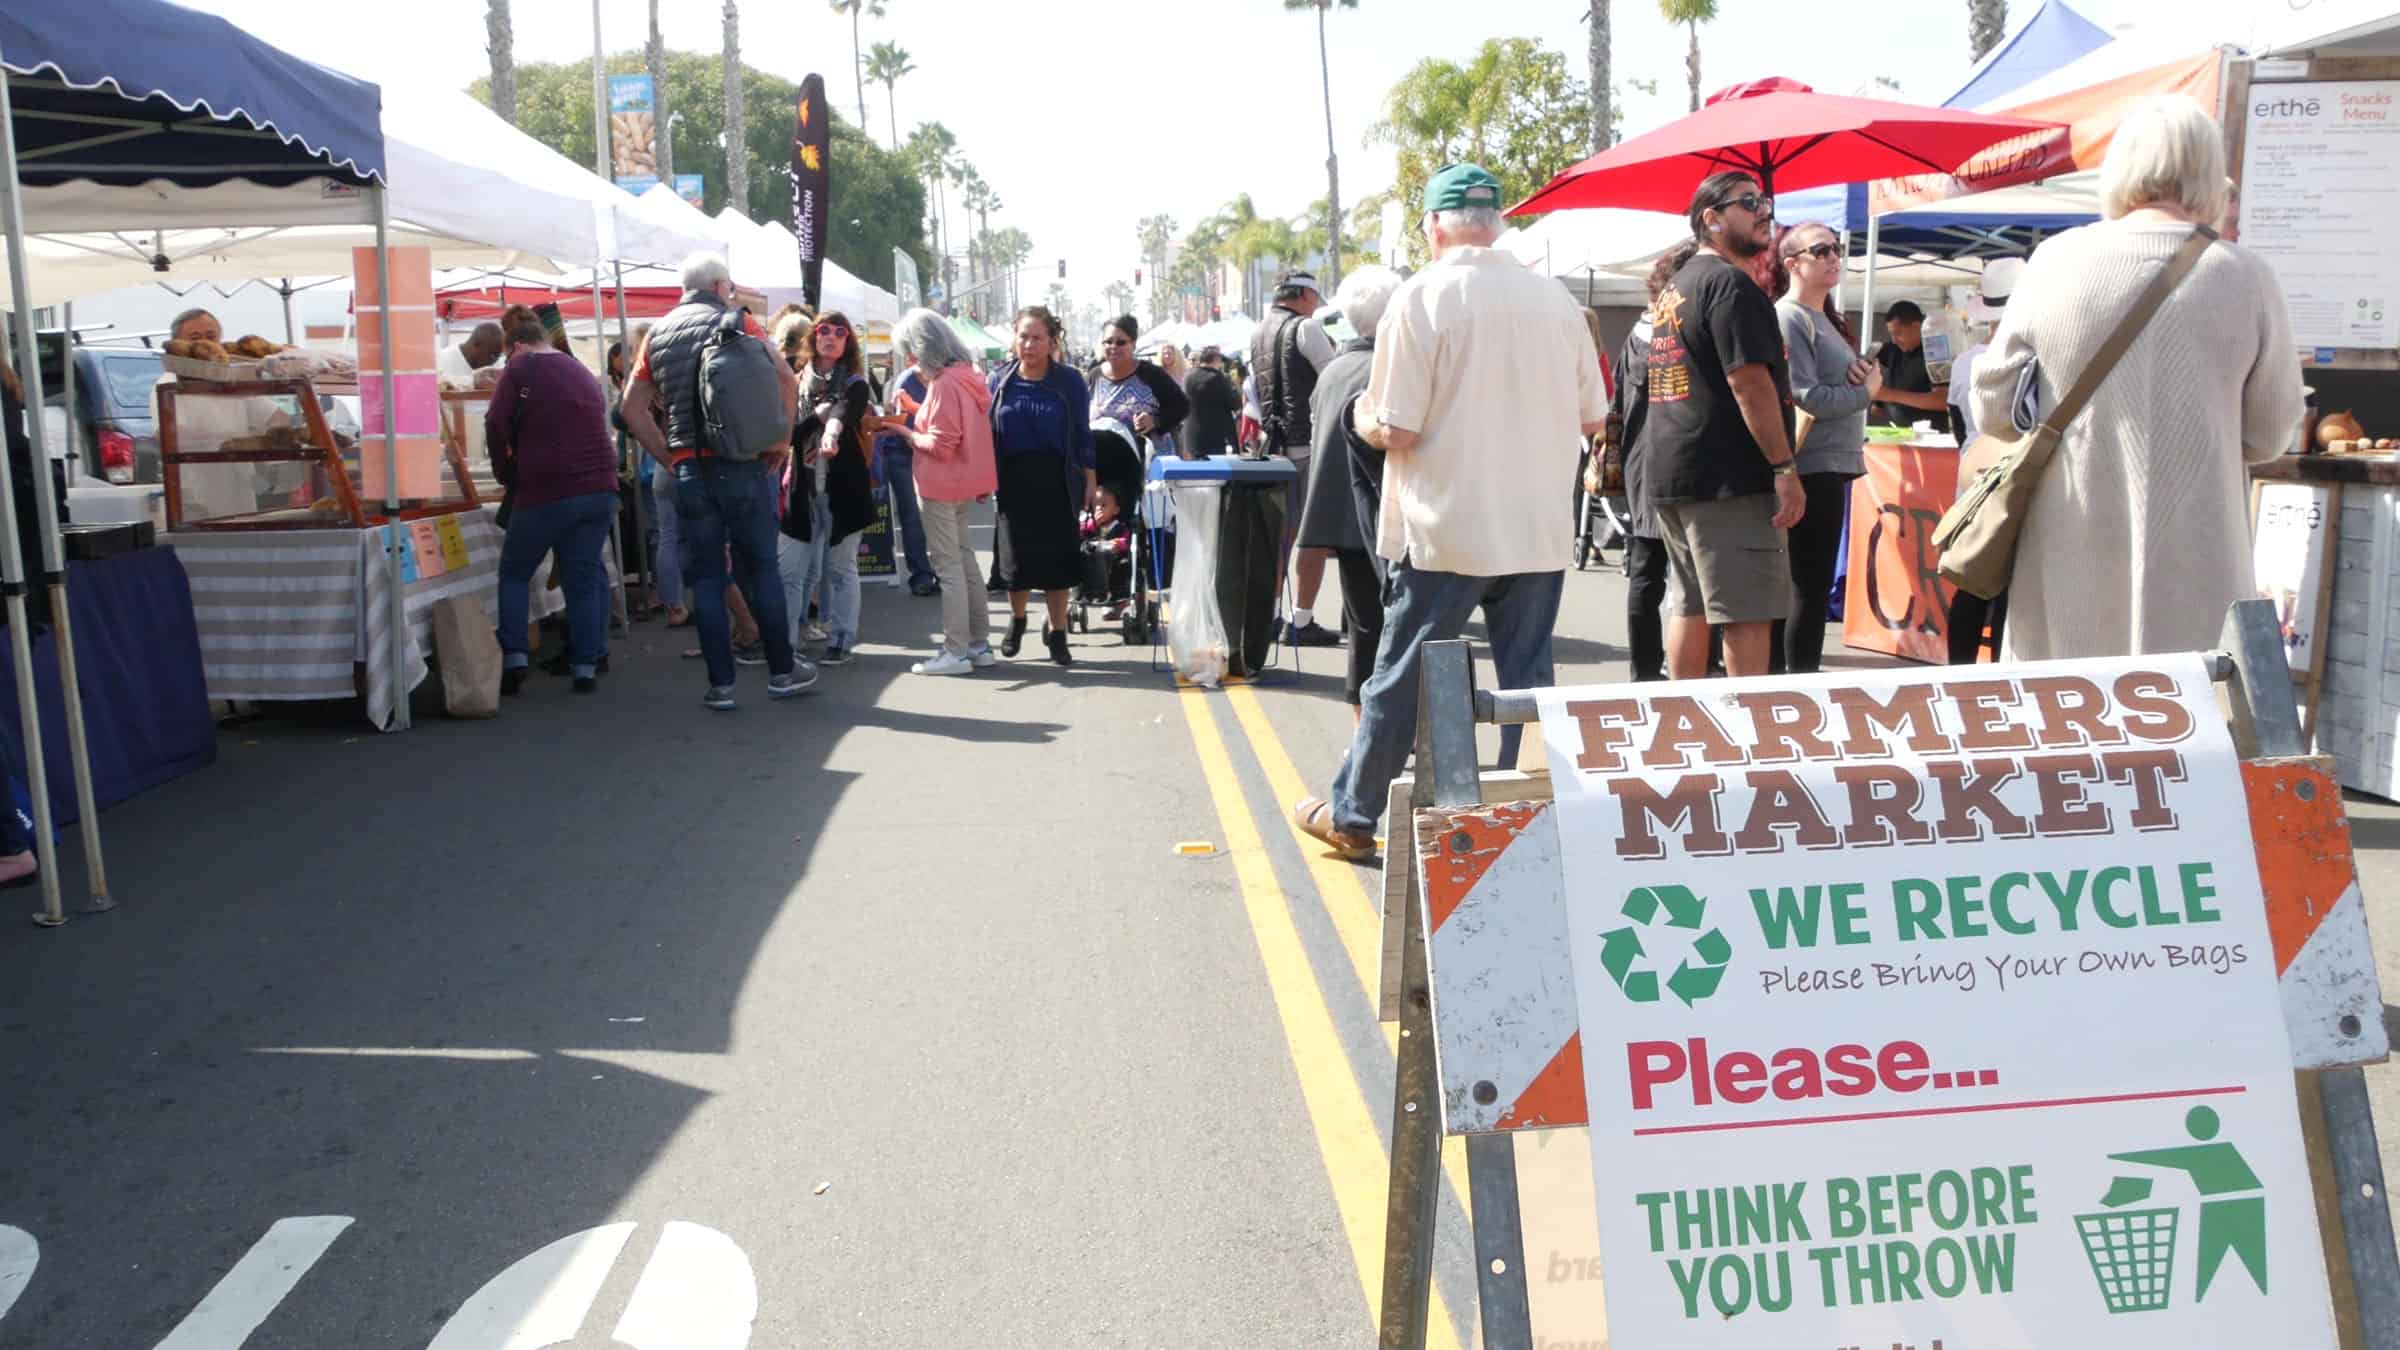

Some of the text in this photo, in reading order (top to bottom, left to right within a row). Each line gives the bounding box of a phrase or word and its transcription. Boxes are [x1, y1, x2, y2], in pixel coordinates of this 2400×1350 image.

[2341, 91, 2393, 106] Snacks
[2343, 108, 2387, 121] Menu
[803, 189, 814, 262] PROTECTION
[1567, 670, 2195, 772] FARMERS
[1608, 750, 2186, 861] MARKET
[1749, 862, 2221, 949] WE RECYCLE
[1760, 941, 2249, 995] Please Bring Your Own Bags
[1627, 1037, 2000, 1109] Please...
[1636, 1164, 2038, 1252] THINK BEFORE
[1668, 1233, 2016, 1319] YOU THROW
